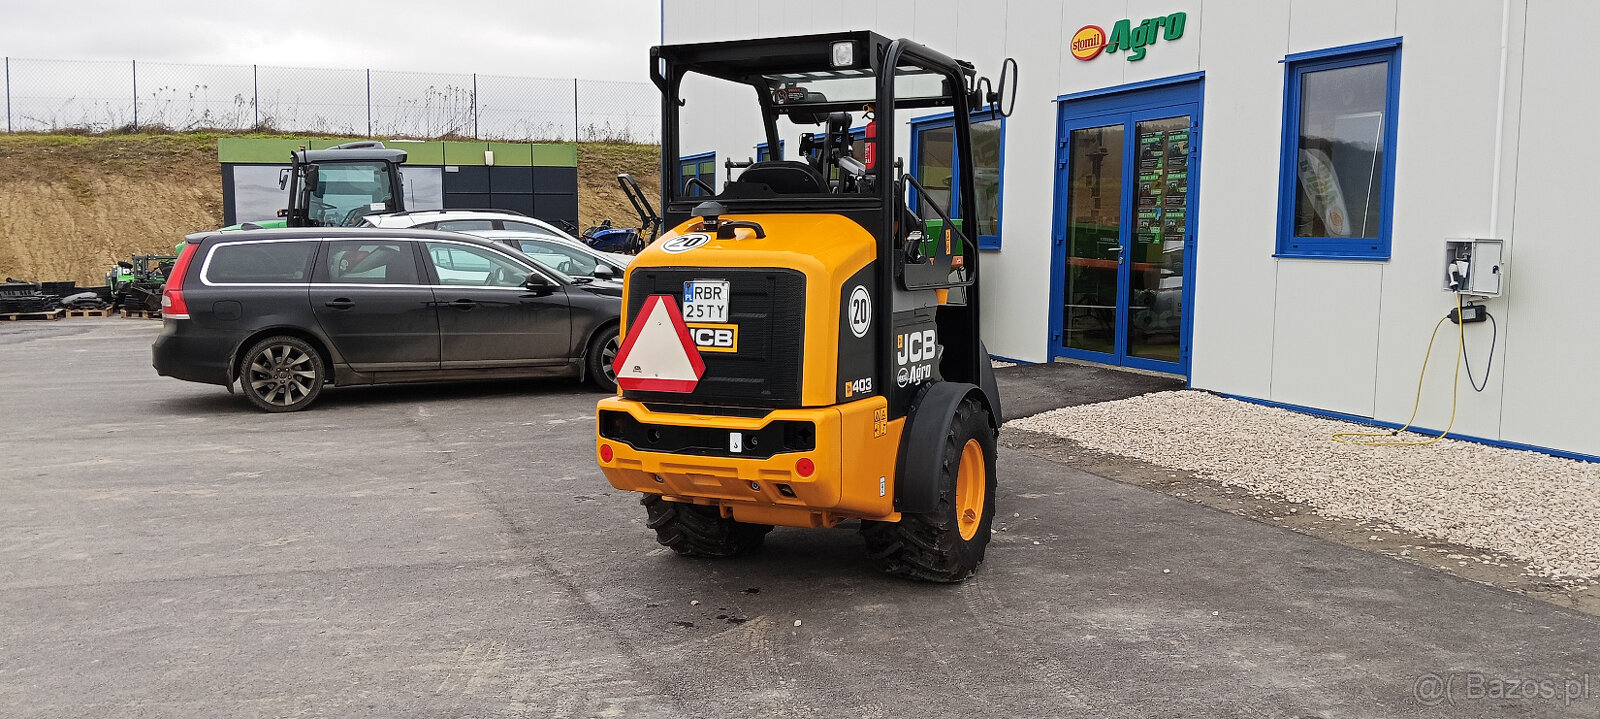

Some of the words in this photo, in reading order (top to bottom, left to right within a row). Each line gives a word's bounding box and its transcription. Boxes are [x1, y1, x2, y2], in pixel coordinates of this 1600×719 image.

[1072, 33, 1100, 51] stomil
[1106, 12, 1187, 62] Agro
[667, 236, 701, 248] 20
[694, 286, 722, 300] RBR
[686, 304, 724, 318] 25TY
[853, 299, 867, 325] 20
[897, 329, 936, 366] JCB
[908, 363, 932, 386] Agro
[852, 377, 872, 393] 403
